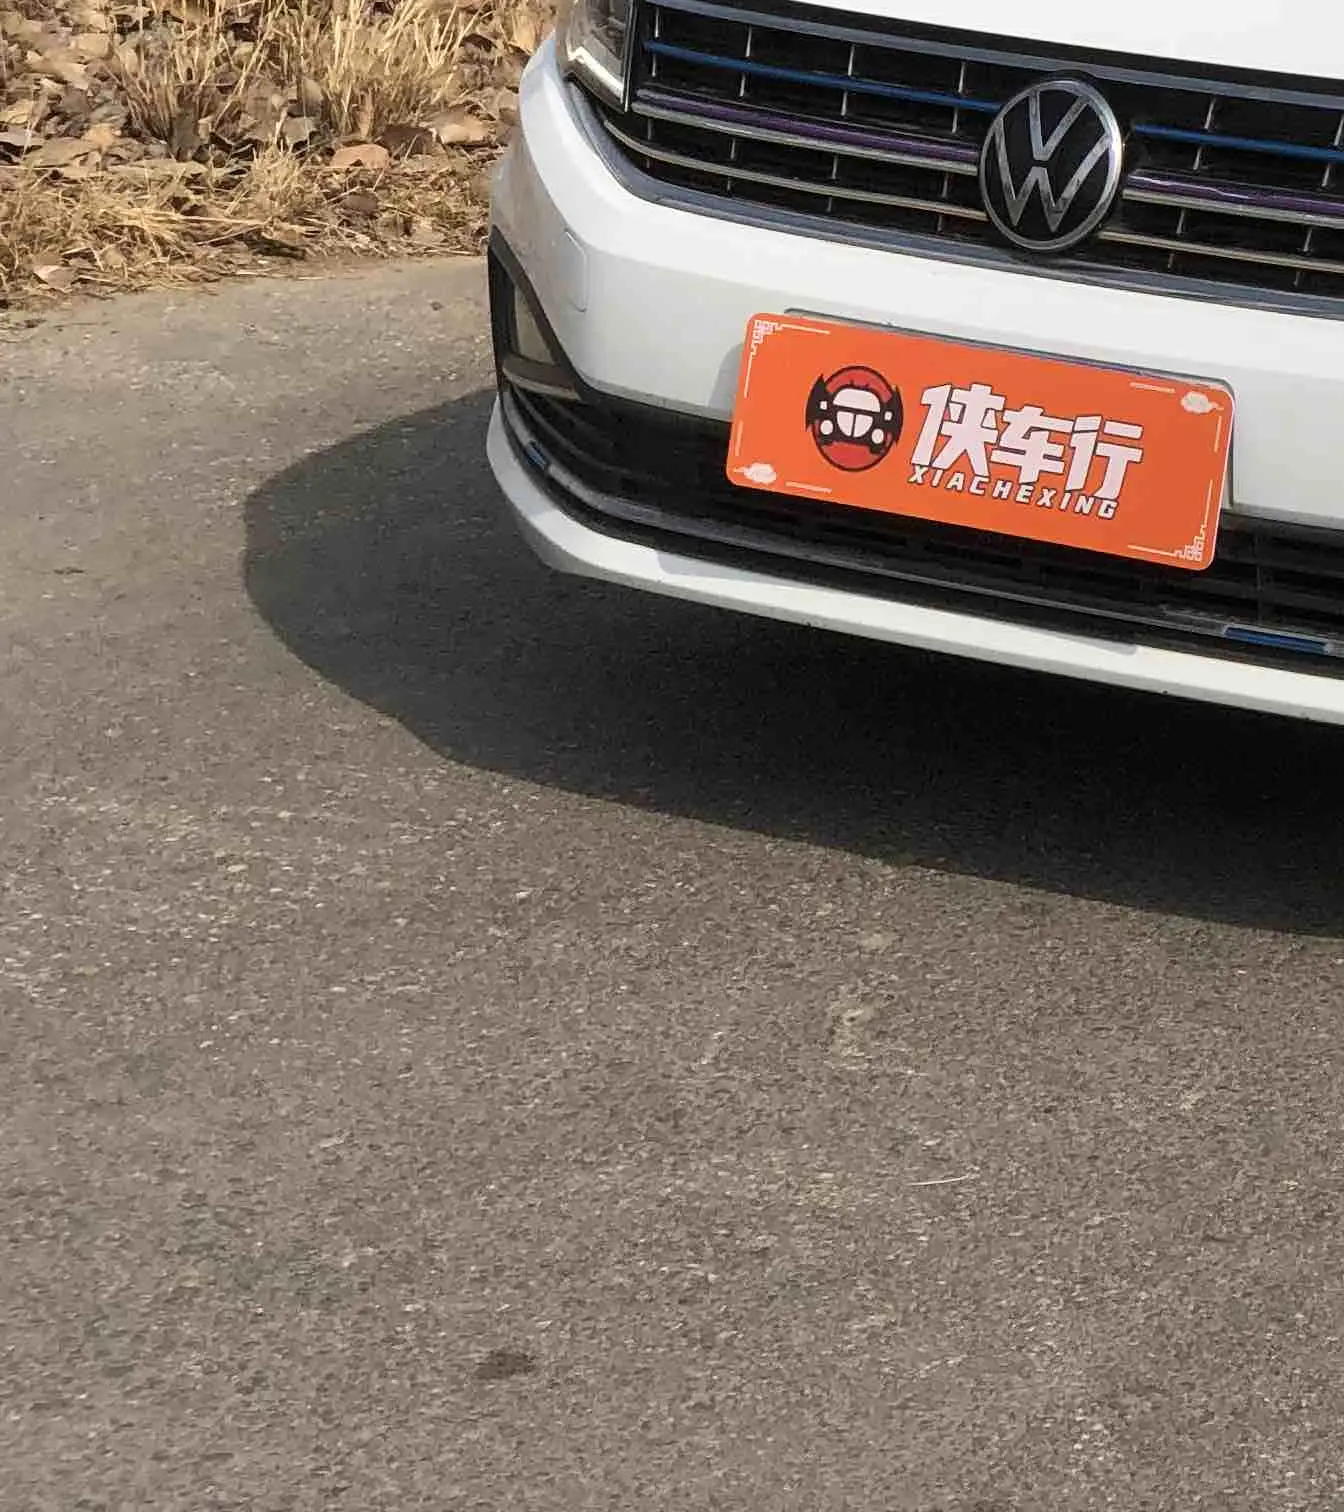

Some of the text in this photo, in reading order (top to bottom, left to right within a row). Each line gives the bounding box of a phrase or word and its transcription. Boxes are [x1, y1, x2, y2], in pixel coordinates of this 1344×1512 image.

[910, 383, 1144, 501] 侠车行
[907, 464, 1119, 521] XIACHEXING
